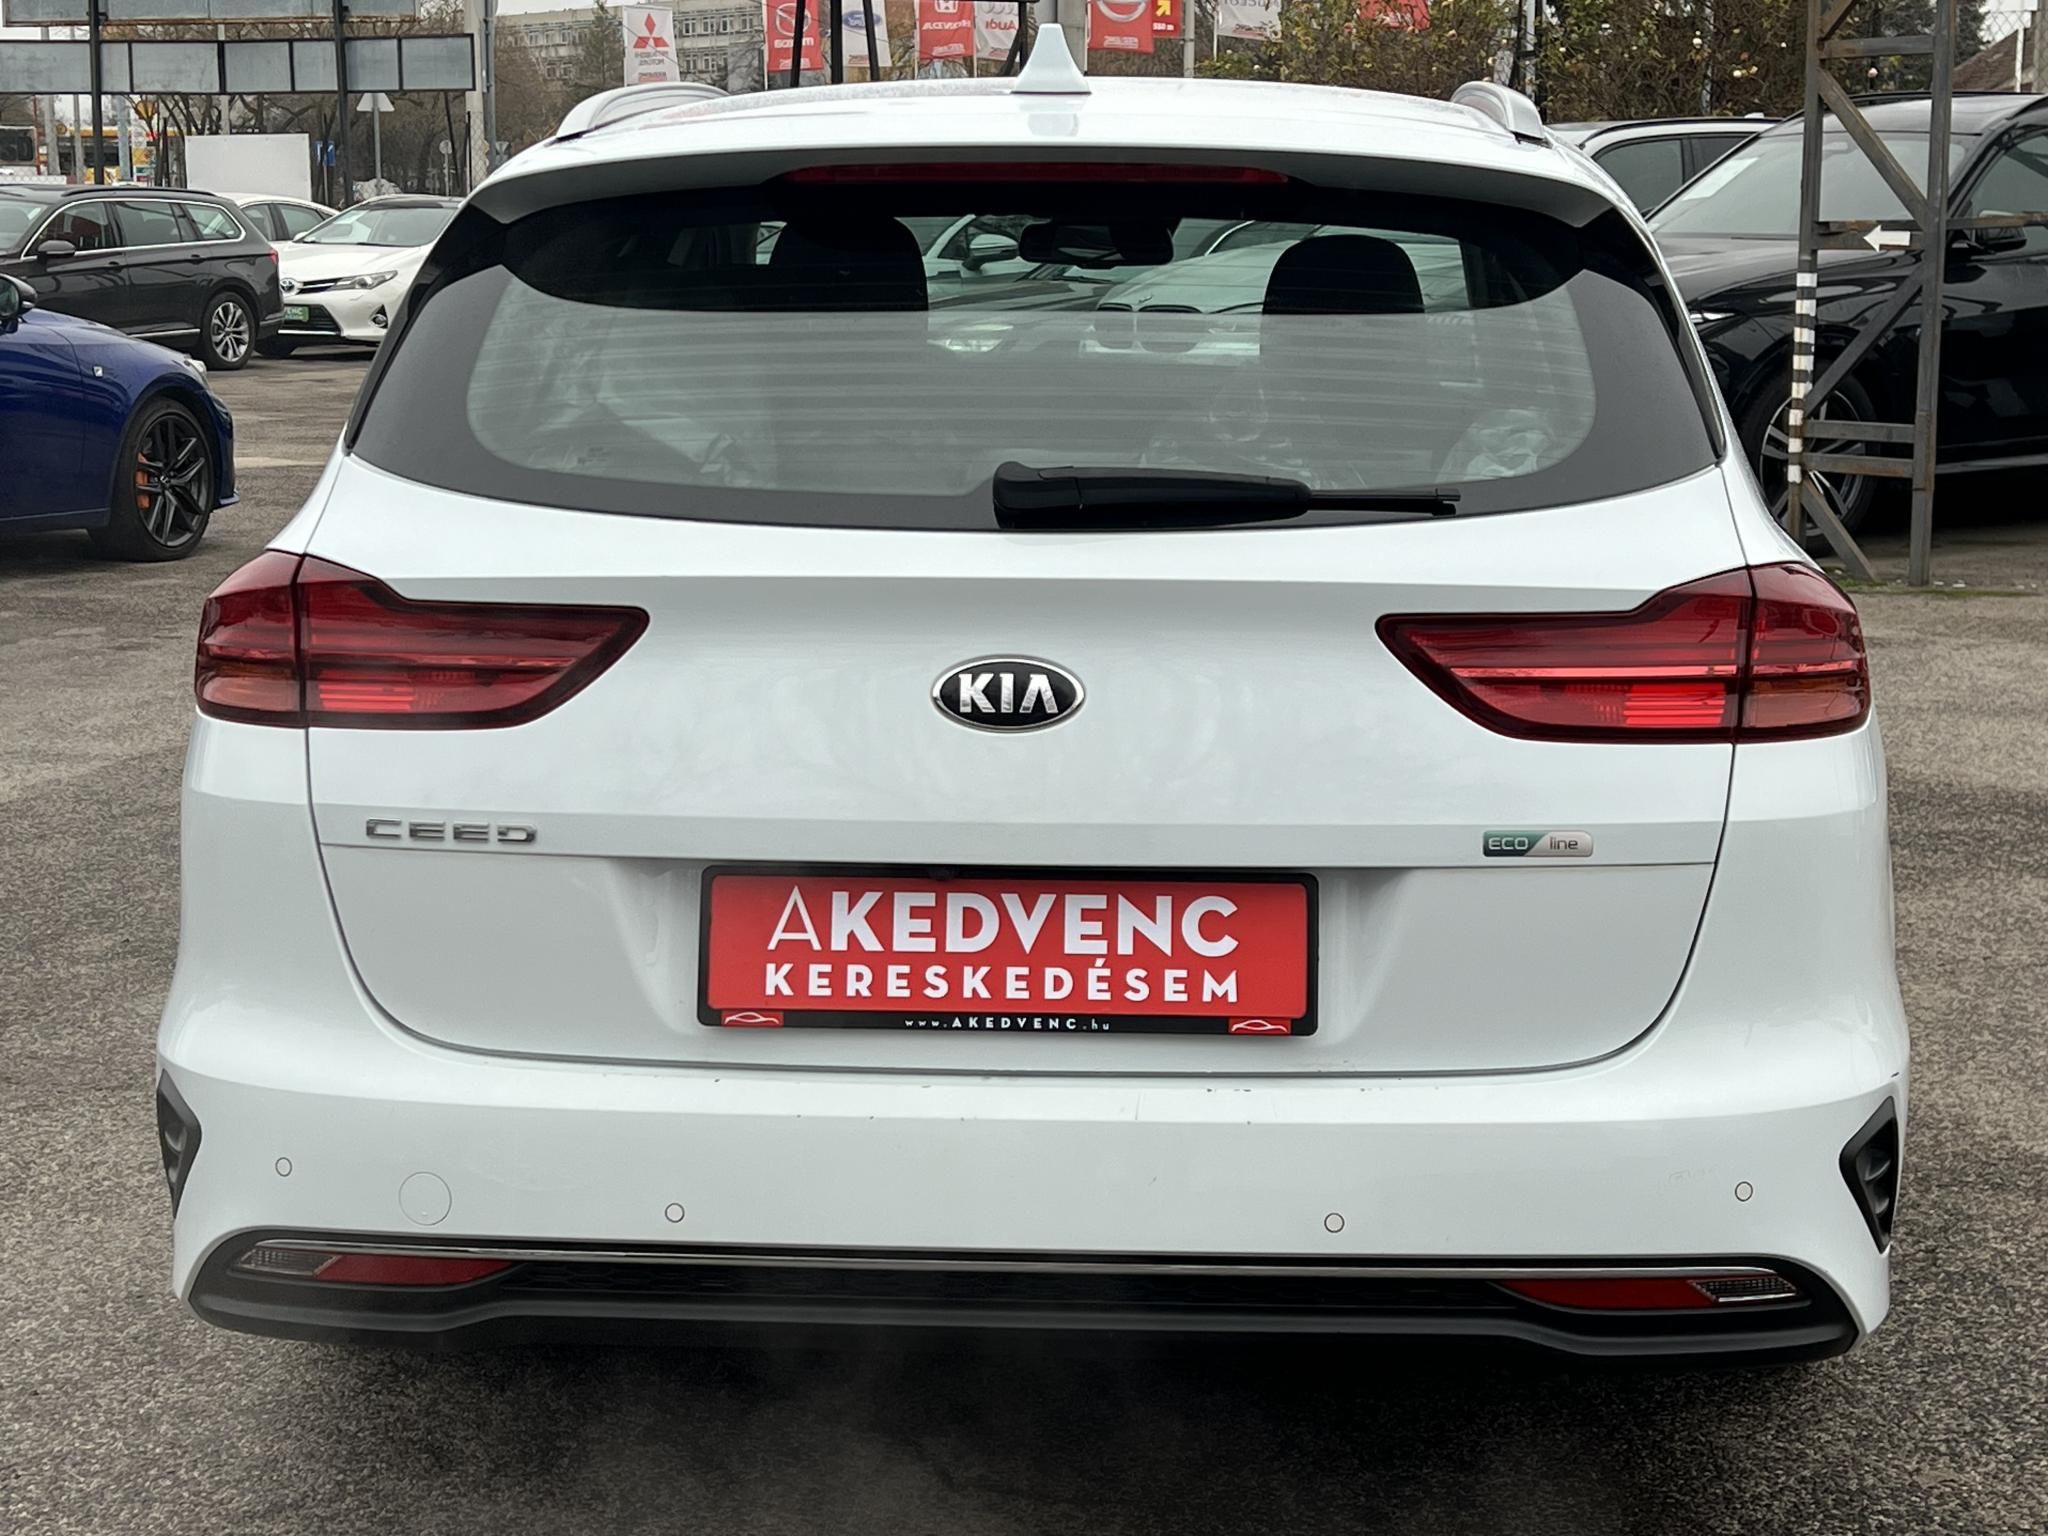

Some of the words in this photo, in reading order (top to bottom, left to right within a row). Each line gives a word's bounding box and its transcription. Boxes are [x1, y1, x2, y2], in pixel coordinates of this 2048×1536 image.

[959, 673, 1058, 713] KIA
[366, 818, 538, 843] CEED
[1488, 837, 1529, 850] ECO
[1549, 836, 1579, 850] line
[767, 885, 1239, 957] AKEDVENC
[765, 958, 1239, 1003] KERESKEDÉSEM
[905, 1017, 1109, 1030] www.AKEDVENC.hu
